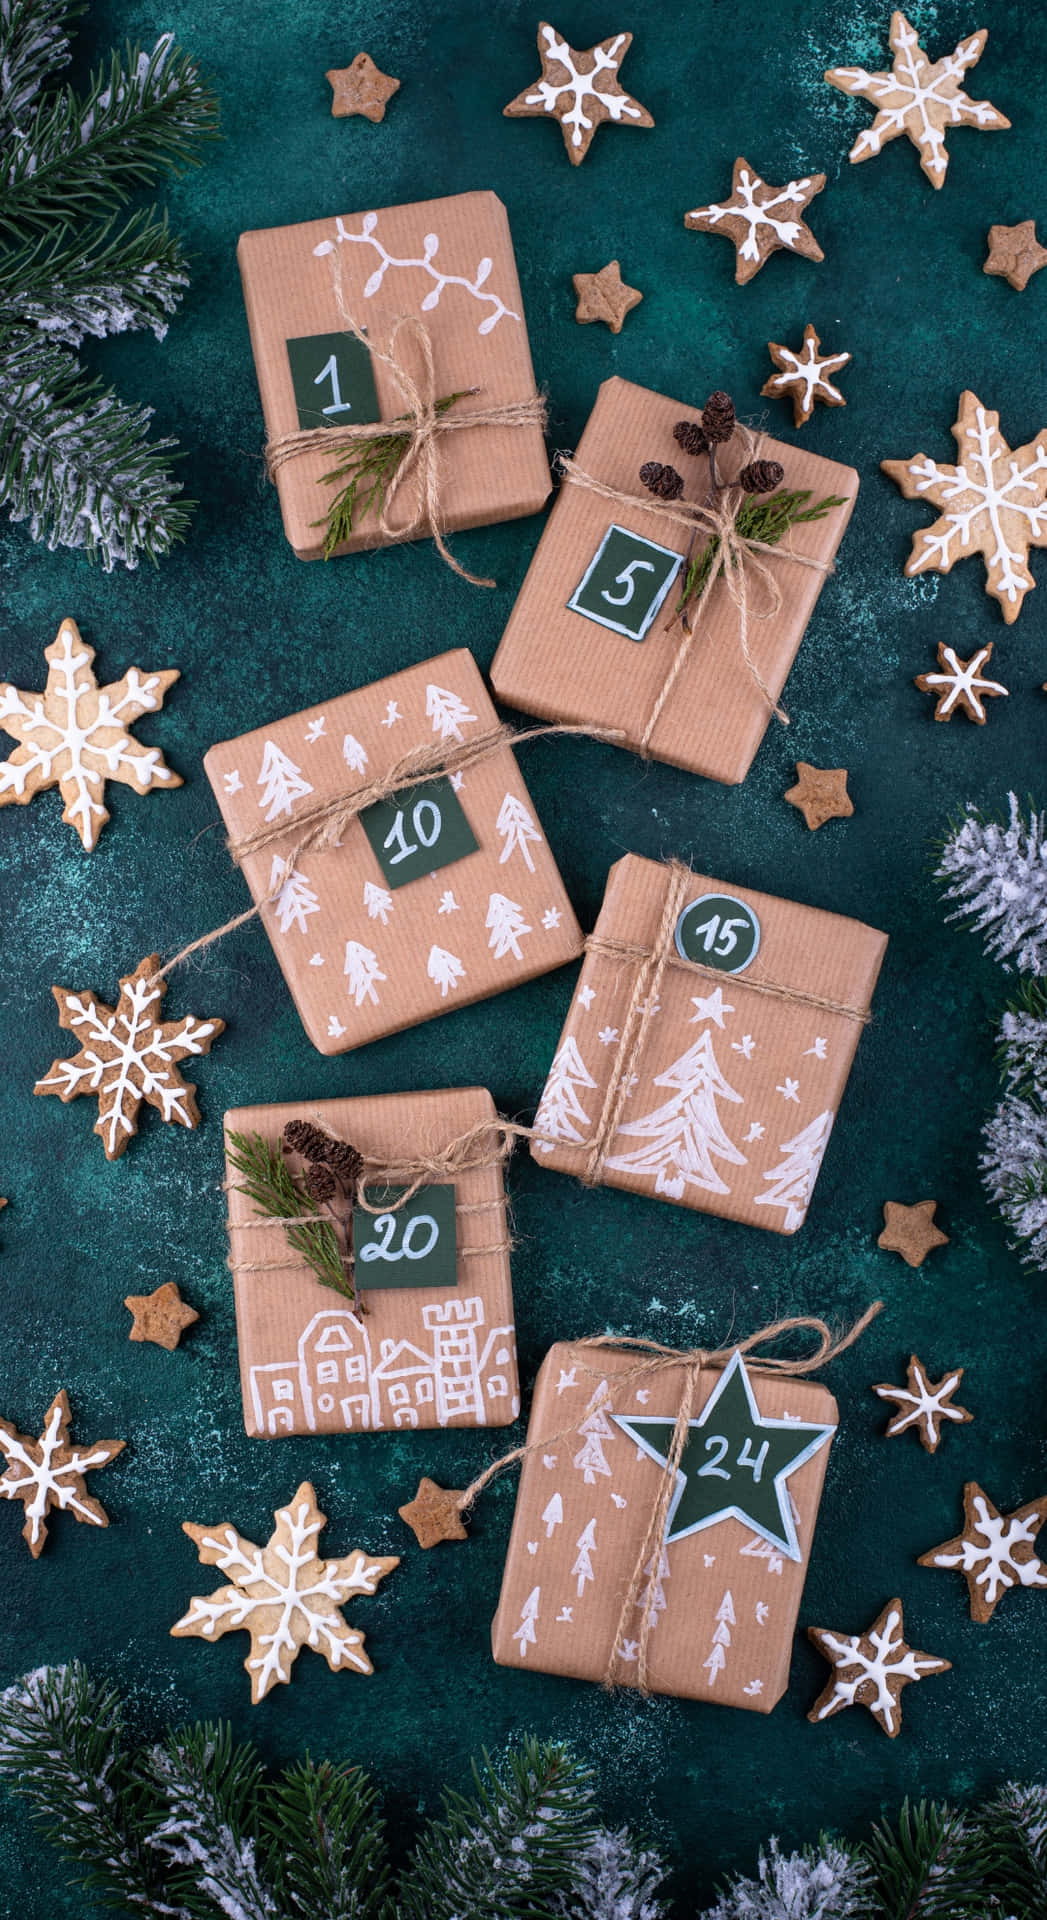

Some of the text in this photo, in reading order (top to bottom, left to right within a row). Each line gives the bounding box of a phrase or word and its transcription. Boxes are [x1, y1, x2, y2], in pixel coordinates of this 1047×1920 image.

[313, 354, 351, 415] 1
[600, 559, 655, 606] 5
[383, 799, 442, 865] 10
[695, 914, 751, 957] 15
[359, 1213, 440, 1263] 20
[697, 1435, 770, 1483] 24
